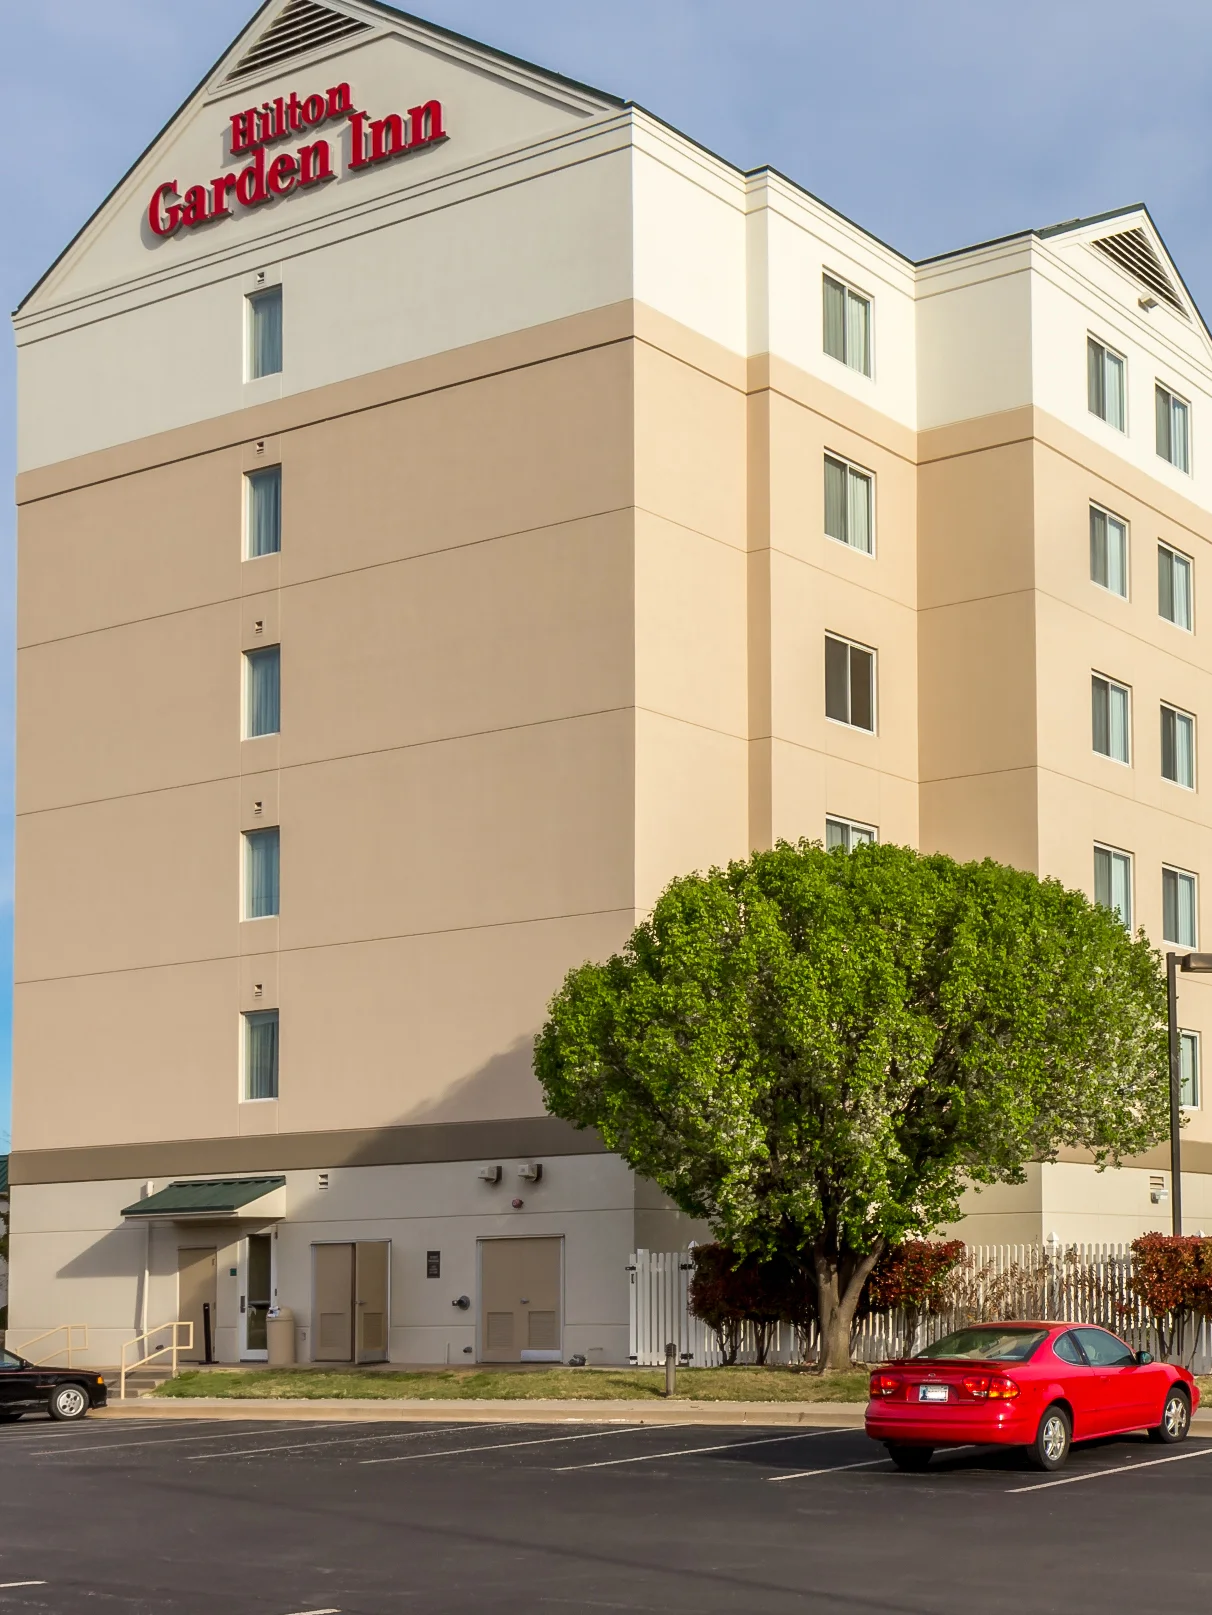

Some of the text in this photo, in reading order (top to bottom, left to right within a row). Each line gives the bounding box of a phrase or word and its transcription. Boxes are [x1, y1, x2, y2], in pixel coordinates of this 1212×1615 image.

[148, 99, 448, 236] Garden Inn
[229, 82, 354, 153] Hilton
